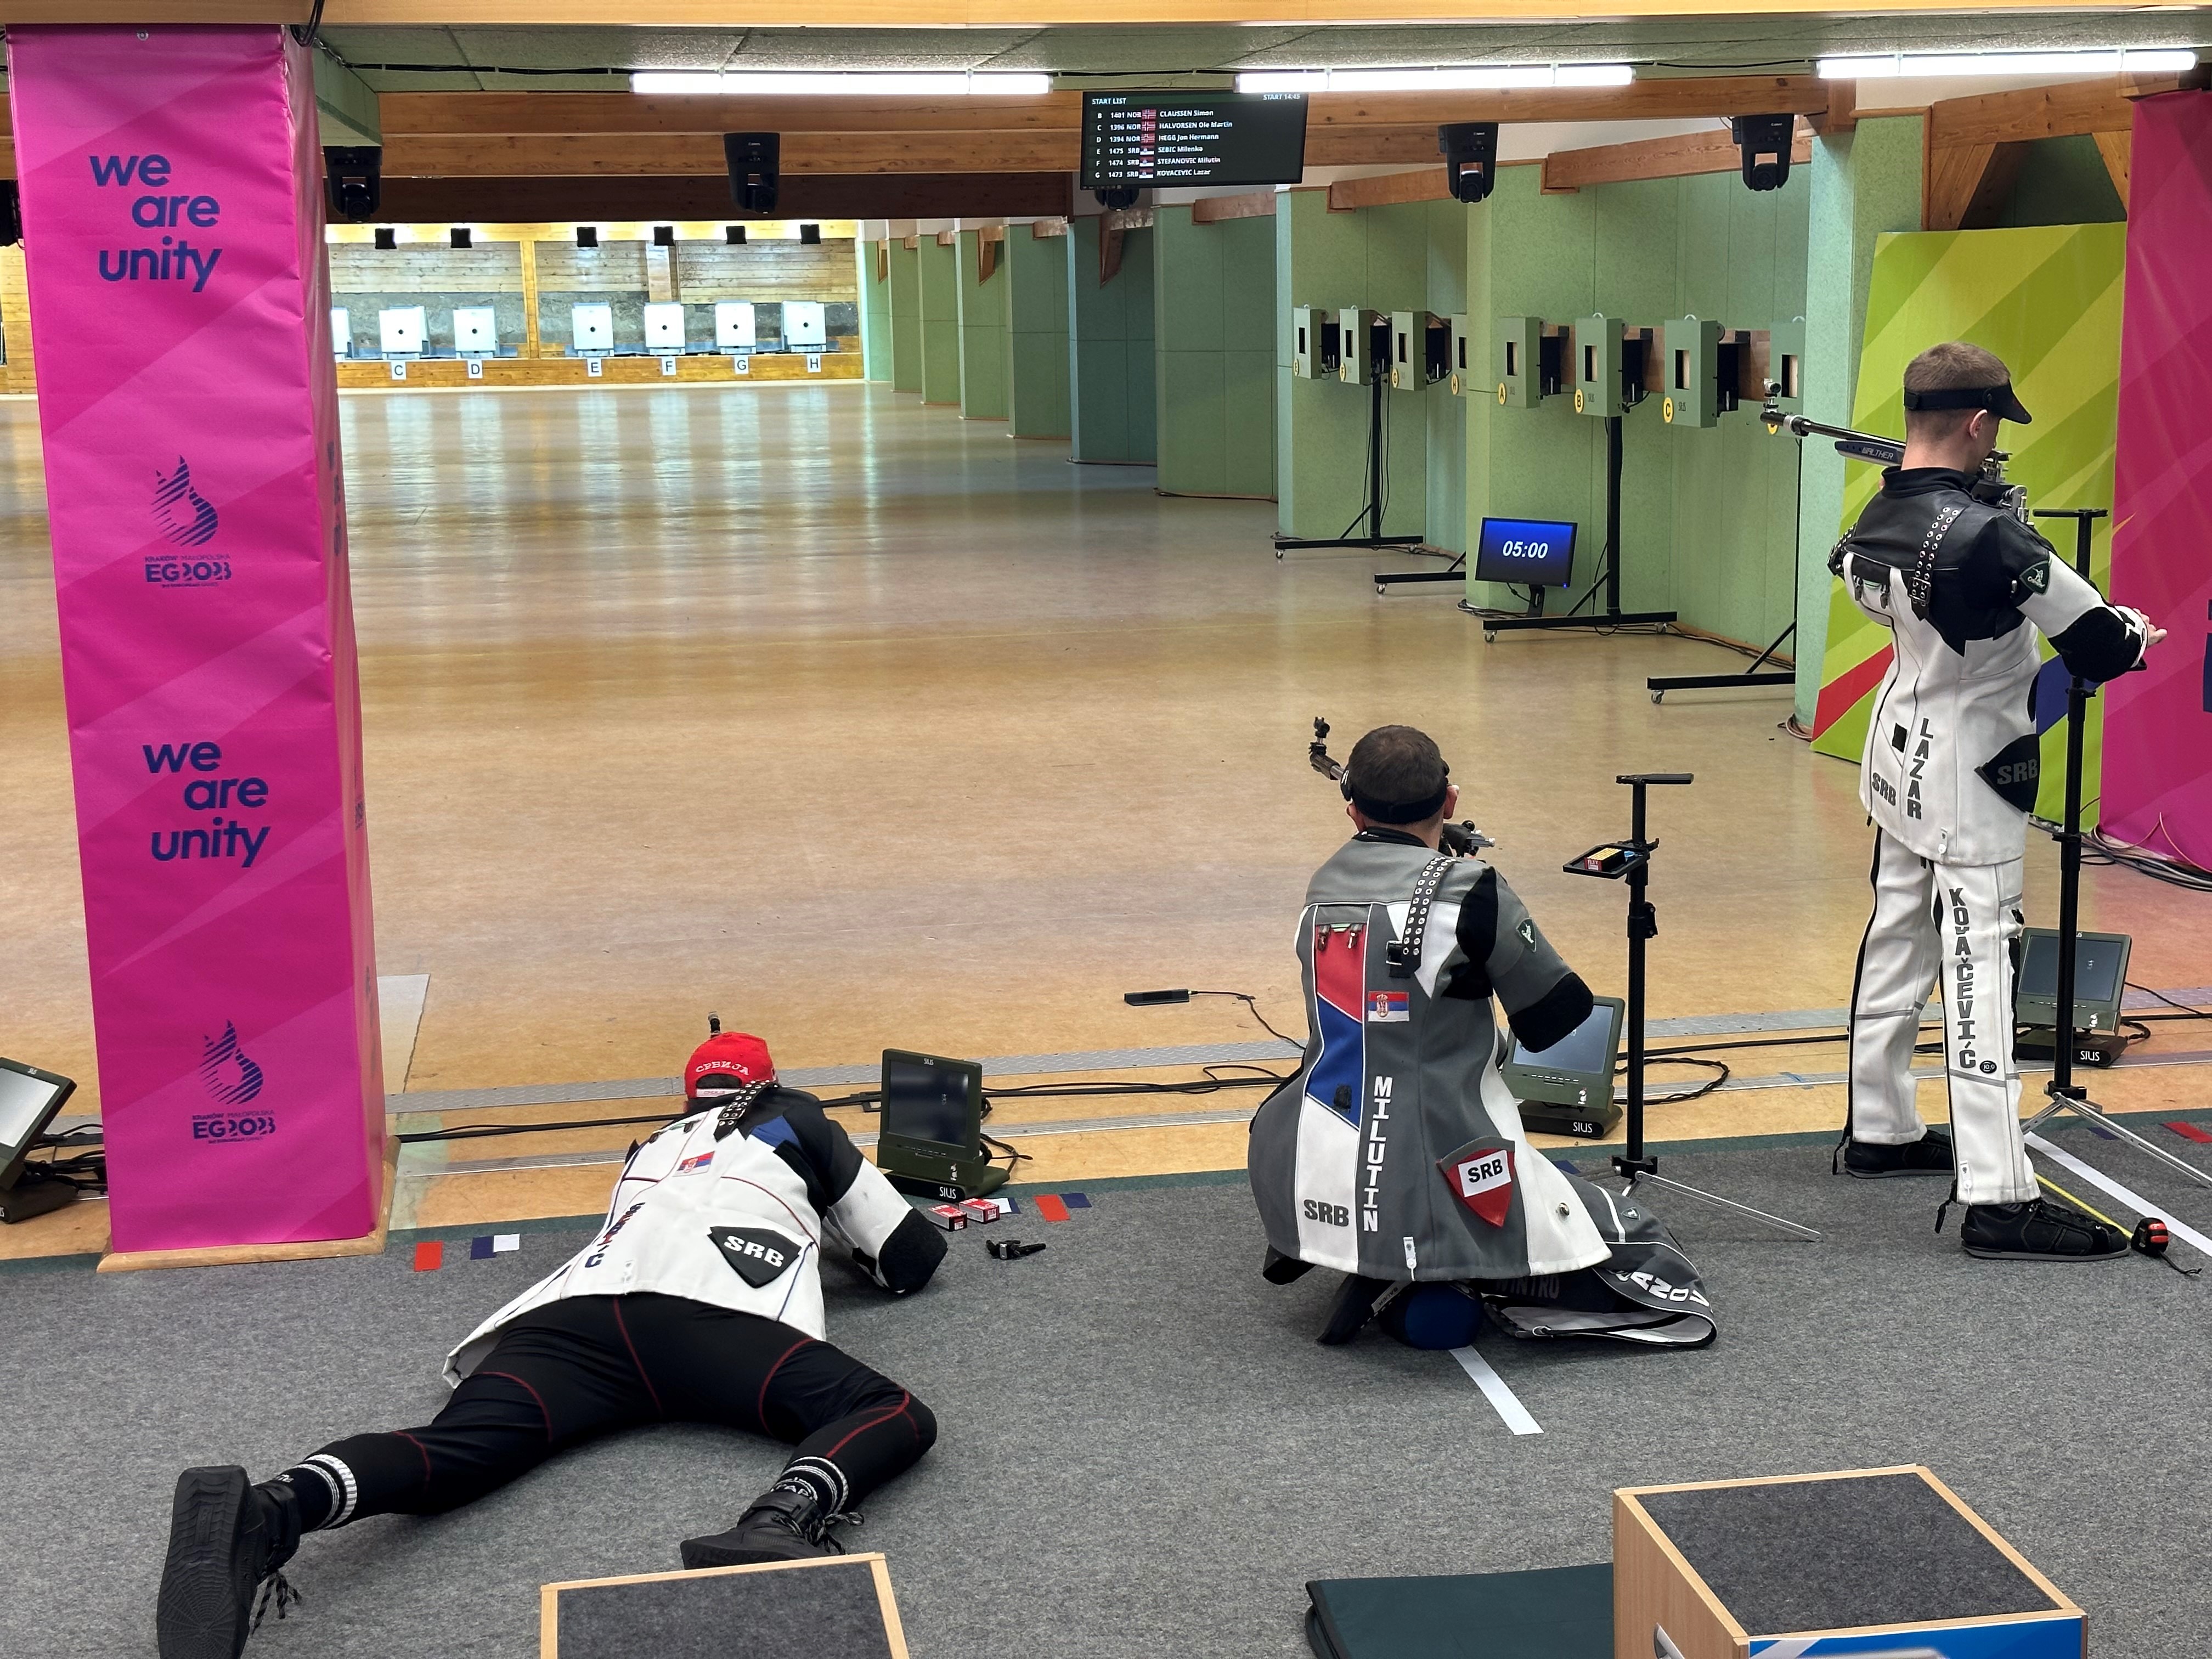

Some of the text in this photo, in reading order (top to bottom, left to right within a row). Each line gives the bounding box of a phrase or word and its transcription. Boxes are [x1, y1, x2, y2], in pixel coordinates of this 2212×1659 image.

[89, 154, 171, 187] we
[132, 196, 220, 228] are
[99, 236, 223, 293] unity
[394, 364, 404, 376] C
[471, 364, 480, 375] D
[591, 362, 599, 373] E
[665, 360, 673, 372] F
[737, 359, 747, 371] G
[810, 358, 819, 369] H
[1861, 447, 1894, 460] WALTHER
[1503, 540, 1548, 559] 05:00
[143, 741, 222, 774] we
[1907, 718, 1933, 820] LAZAR
[1997, 758, 2038, 785] SRB
[184, 777, 268, 810] are
[1872, 772, 1897, 806] SRB
[151, 817, 271, 868] unity
[2080, 1050, 2100, 1061] SIUS
[1572, 1121, 1593, 1133] SIUS
[1363, 1076, 1393, 1232] MILUTIN
[1468, 1158, 1503, 1183] SRB
[939, 1186, 957, 1199] SIUS
[1304, 1199, 1349, 1227] SRB
[724, 1235, 784, 1267] SRB
